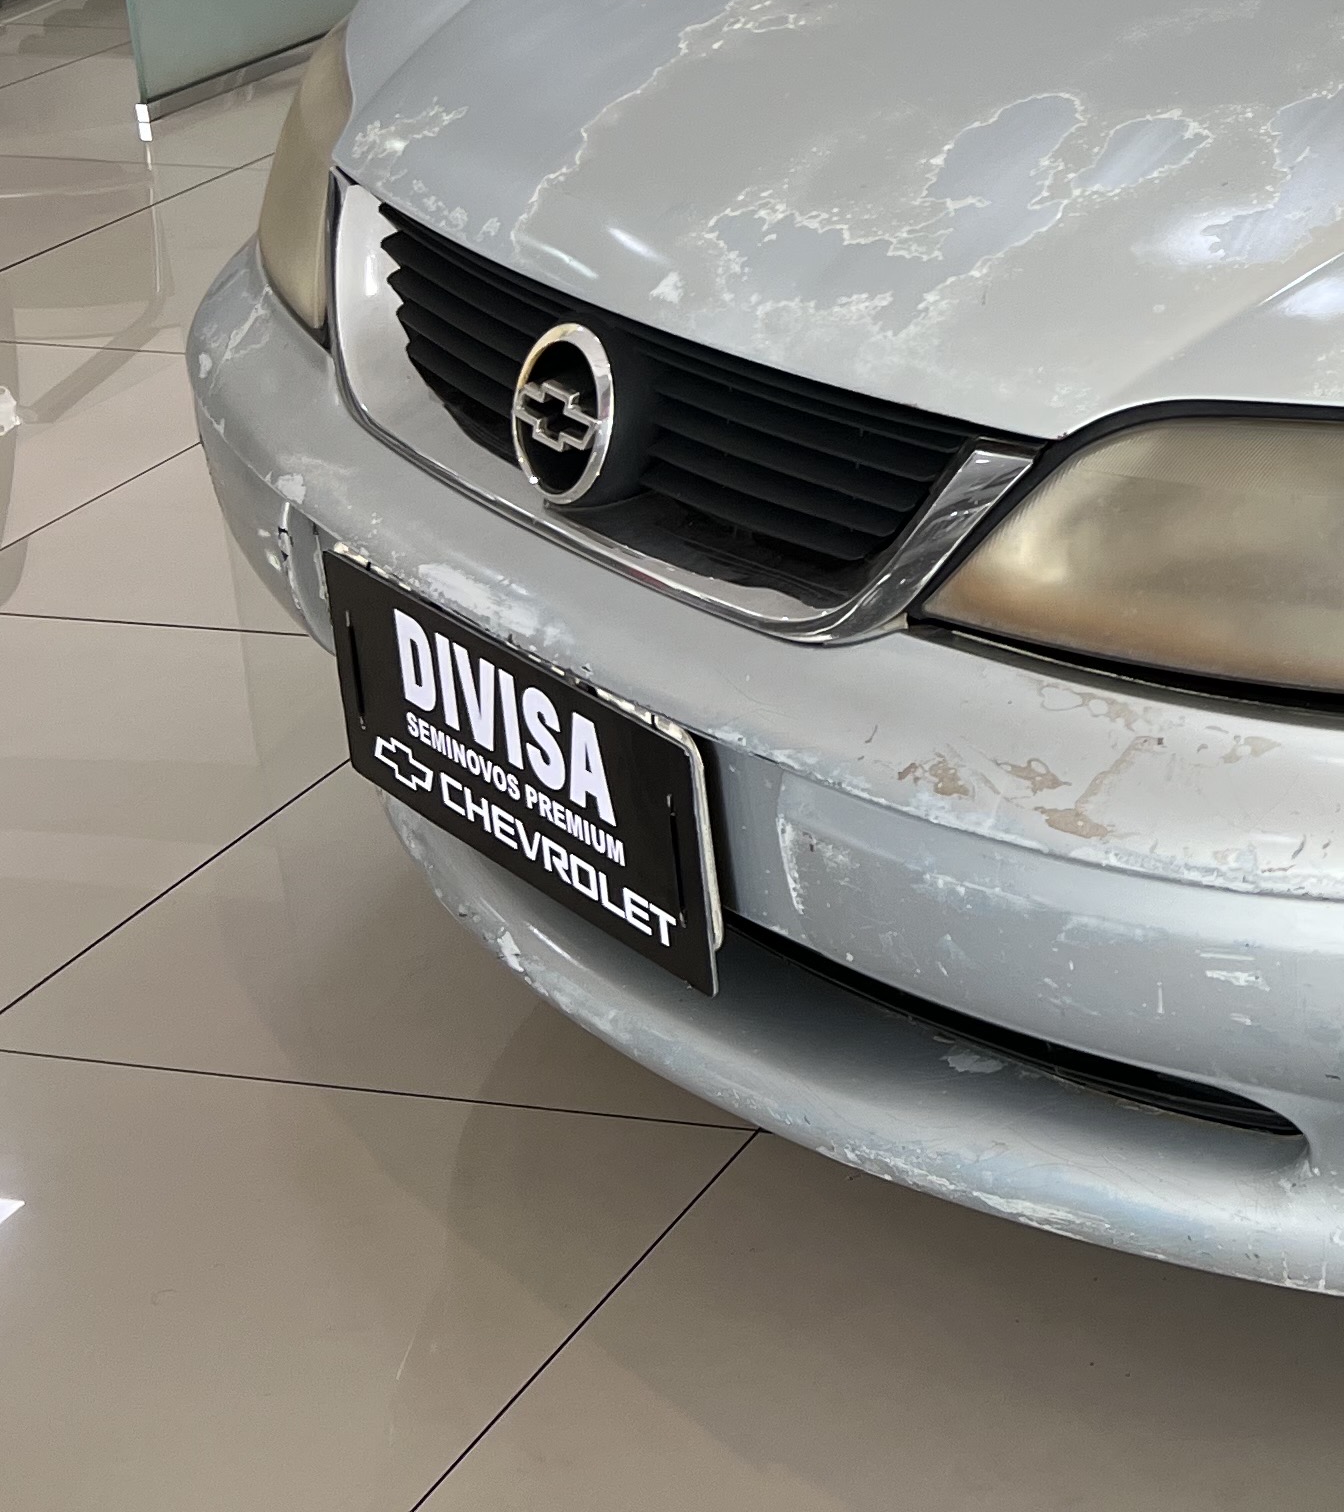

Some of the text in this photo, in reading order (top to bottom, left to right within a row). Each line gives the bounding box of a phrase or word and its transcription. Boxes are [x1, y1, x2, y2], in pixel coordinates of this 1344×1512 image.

[394, 608, 617, 827] DIVISA
[406, 710, 626, 867] SEMINOVOS PREMIUM
[440, 772, 677, 947] CHEVROLET
